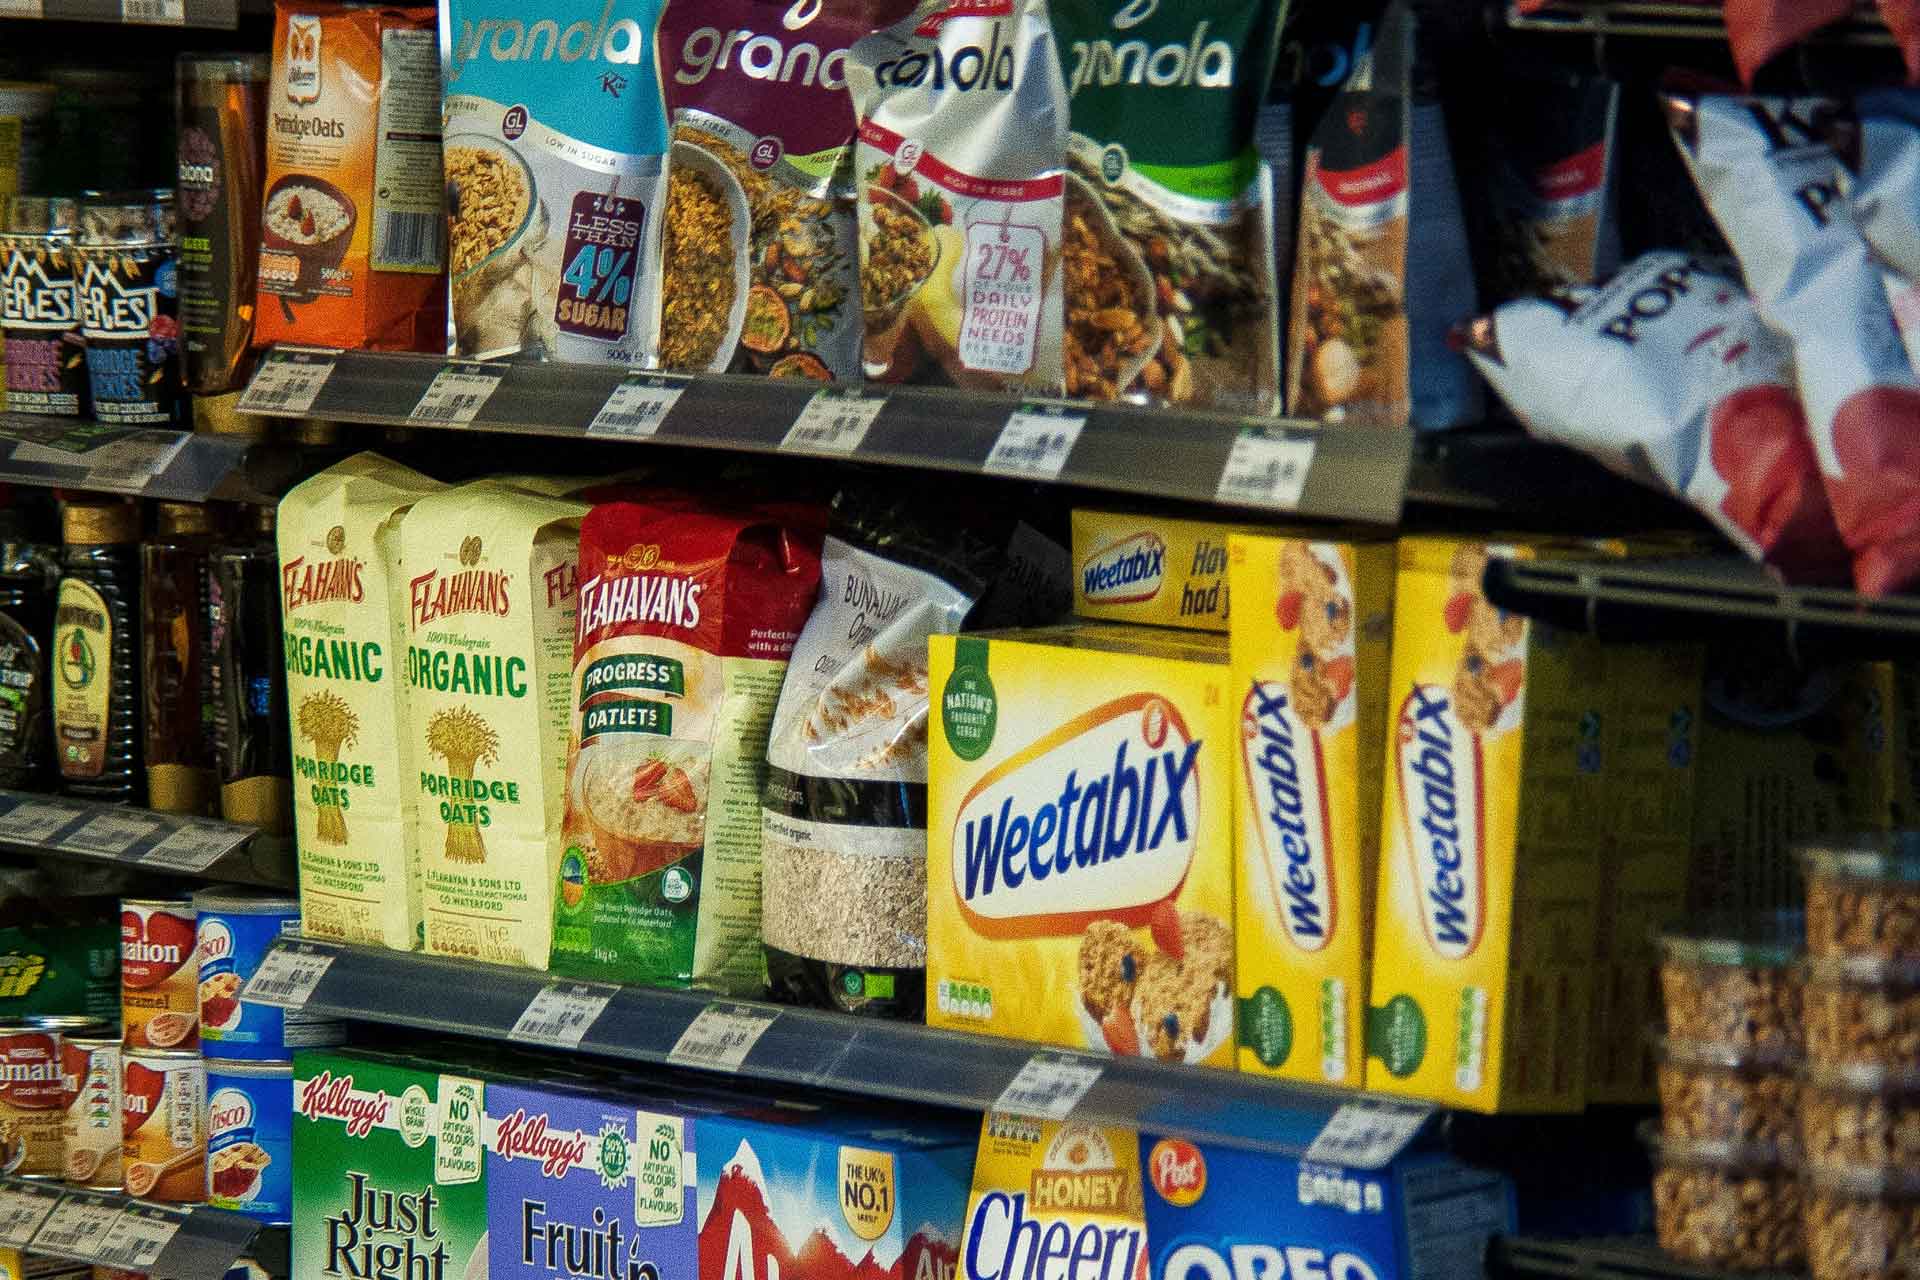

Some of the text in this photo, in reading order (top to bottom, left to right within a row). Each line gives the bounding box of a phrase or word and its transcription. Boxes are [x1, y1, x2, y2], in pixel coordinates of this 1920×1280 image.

[674, 26, 852, 91] grano
[312, 116, 345, 139] Oats
[506, 112, 524, 128] GL
[545, 135, 566, 149] LOW
[581, 151, 618, 168] SUGAR
[757, 143, 775, 158] GL
[571, 227, 637, 248] THAN
[573, 212, 641, 238] LESS
[562, 243, 631, 306] 4%
[975, 243, 1032, 282] 27%
[973, 290, 1032, 308] DAILY
[558, 298, 627, 332] SUGAR
[972, 307, 1029, 328] PROTEIN
[967, 327, 1025, 346] NEEDS
[606, 349, 631, 363] 500g
[1084, 542, 1166, 594] Weetabix
[409, 568, 511, 633] FLAHAVAN'S
[578, 574, 701, 646] FLAHAVAN'S
[1179, 579, 1221, 617] had
[750, 628, 786, 640] Perfect
[408, 645, 528, 699] ORGANIC
[585, 661, 670, 690] PROGRESS
[945, 692, 994, 715] NATION'S
[588, 707, 658, 728] OATLETS
[295, 754, 375, 788] PORRIDGE
[311, 784, 351, 811] OATS
[419, 770, 521, 805] PORRIDGE
[439, 801, 492, 828] OATS
[964, 738, 1203, 901] Weetabix
[1250, 679, 1324, 939] Weetabix
[1410, 682, 1470, 946] Weetabix
[364, 862, 380, 873] LTD
[478, 877, 502, 890] SONS
[503, 879, 522, 892] LTD
[302, 1070, 390, 1138] Kellogg's
[404, 1105, 426, 1117] WHOLE
[450, 1099, 469, 1121] NO
[405, 1116, 425, 1128] GRAIN
[442, 1132, 475, 1147] COLOURS
[452, 1146, 463, 1157] OR
[496, 1109, 587, 1179] Kellogg's
[649, 1139, 670, 1162] NO
[439, 1157, 476, 1173] FLAVOURS
[643, 1162, 676, 1176] ARTIFICIAL
[845, 1162, 863, 1180] THE
[1157, 1146, 1200, 1191] Post
[642, 1174, 677, 1190] COLOURS
[653, 1187, 664, 1198] OR
[1035, 1174, 1123, 1209] HONEY
[346, 1169, 439, 1240] Just
[640, 1198, 679, 1215] FLAVOURS
[844, 1183, 889, 1214] NO.1
[323, 1210, 451, 1280] Right
[522, 1198, 625, 1280] Fruit
